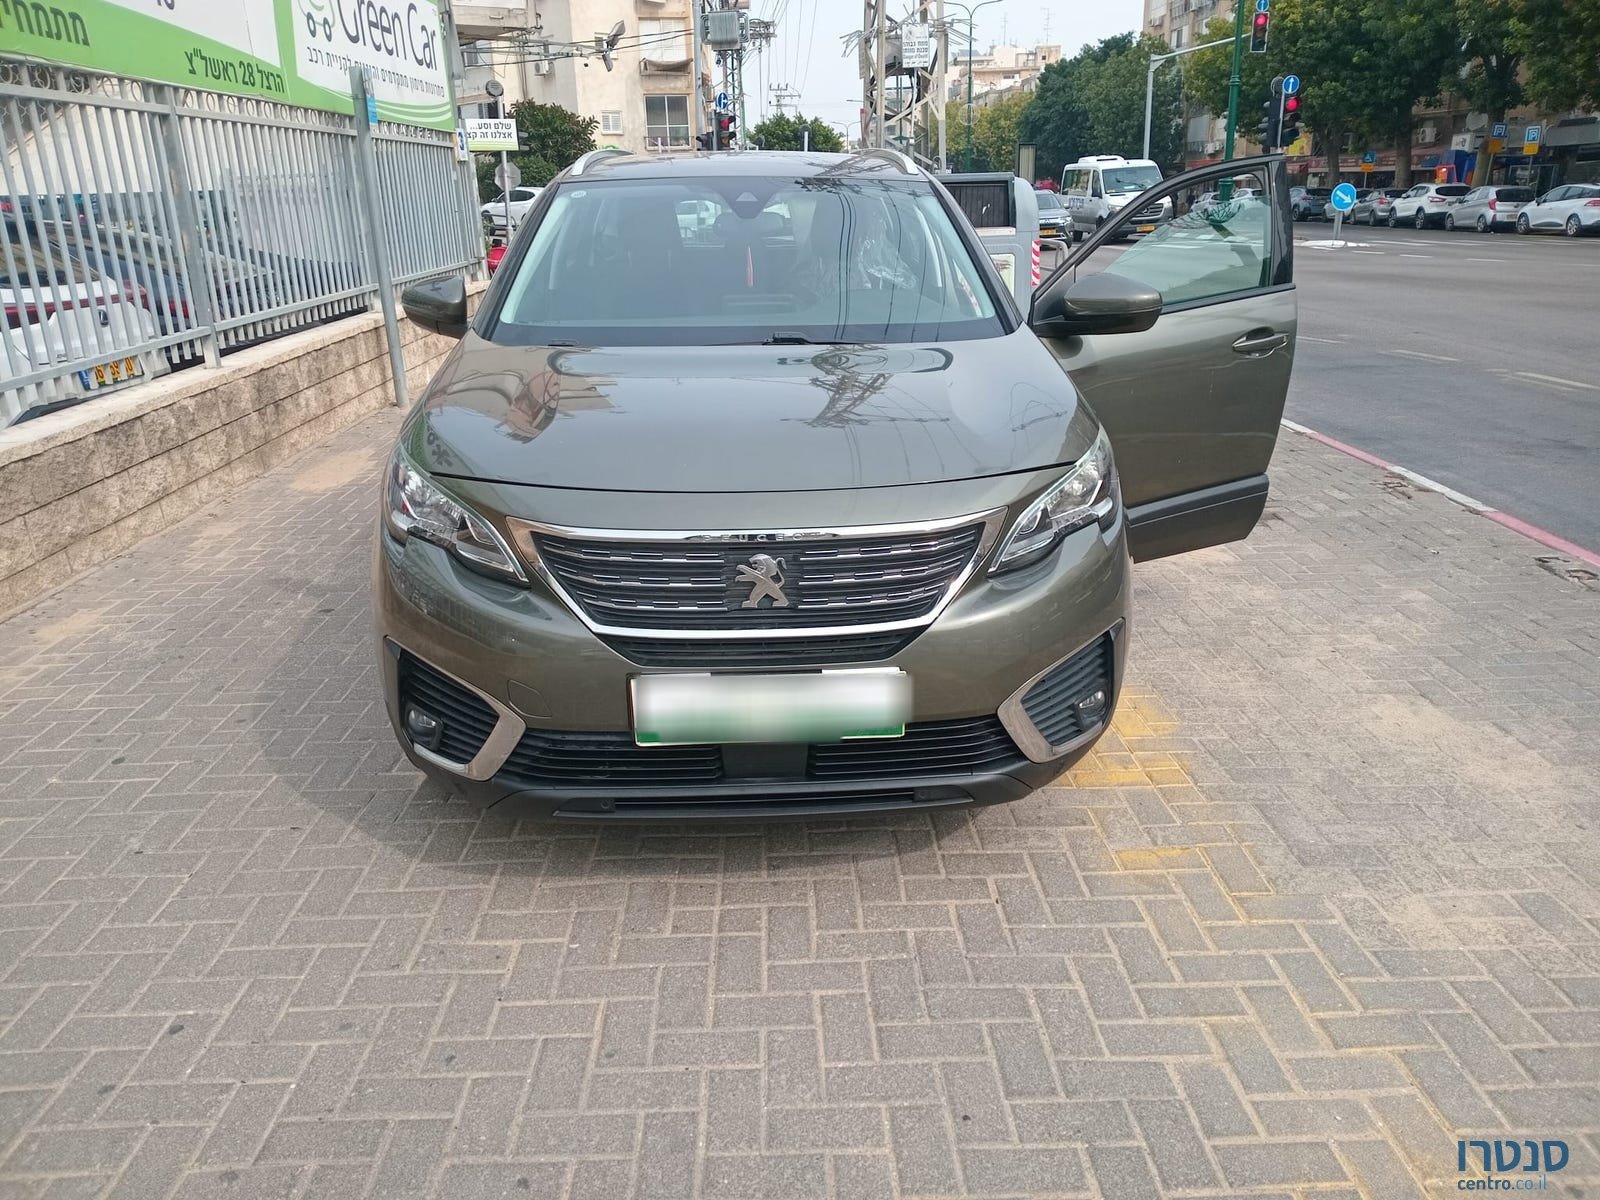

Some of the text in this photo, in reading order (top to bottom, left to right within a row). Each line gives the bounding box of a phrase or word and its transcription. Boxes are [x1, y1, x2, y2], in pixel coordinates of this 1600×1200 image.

[0, 0, 90, 46] מתמחי
[337, 0, 437, 71] Green Car
[307, 46, 324, 66] רכב
[326, 53, 351, 76] לקניית
[239, 60, 256, 87] 28
[256, 64, 285, 93] הרצל
[466, 130, 513, 140] אצלנו זה קצ
[494, 121, 512, 130] שלם
